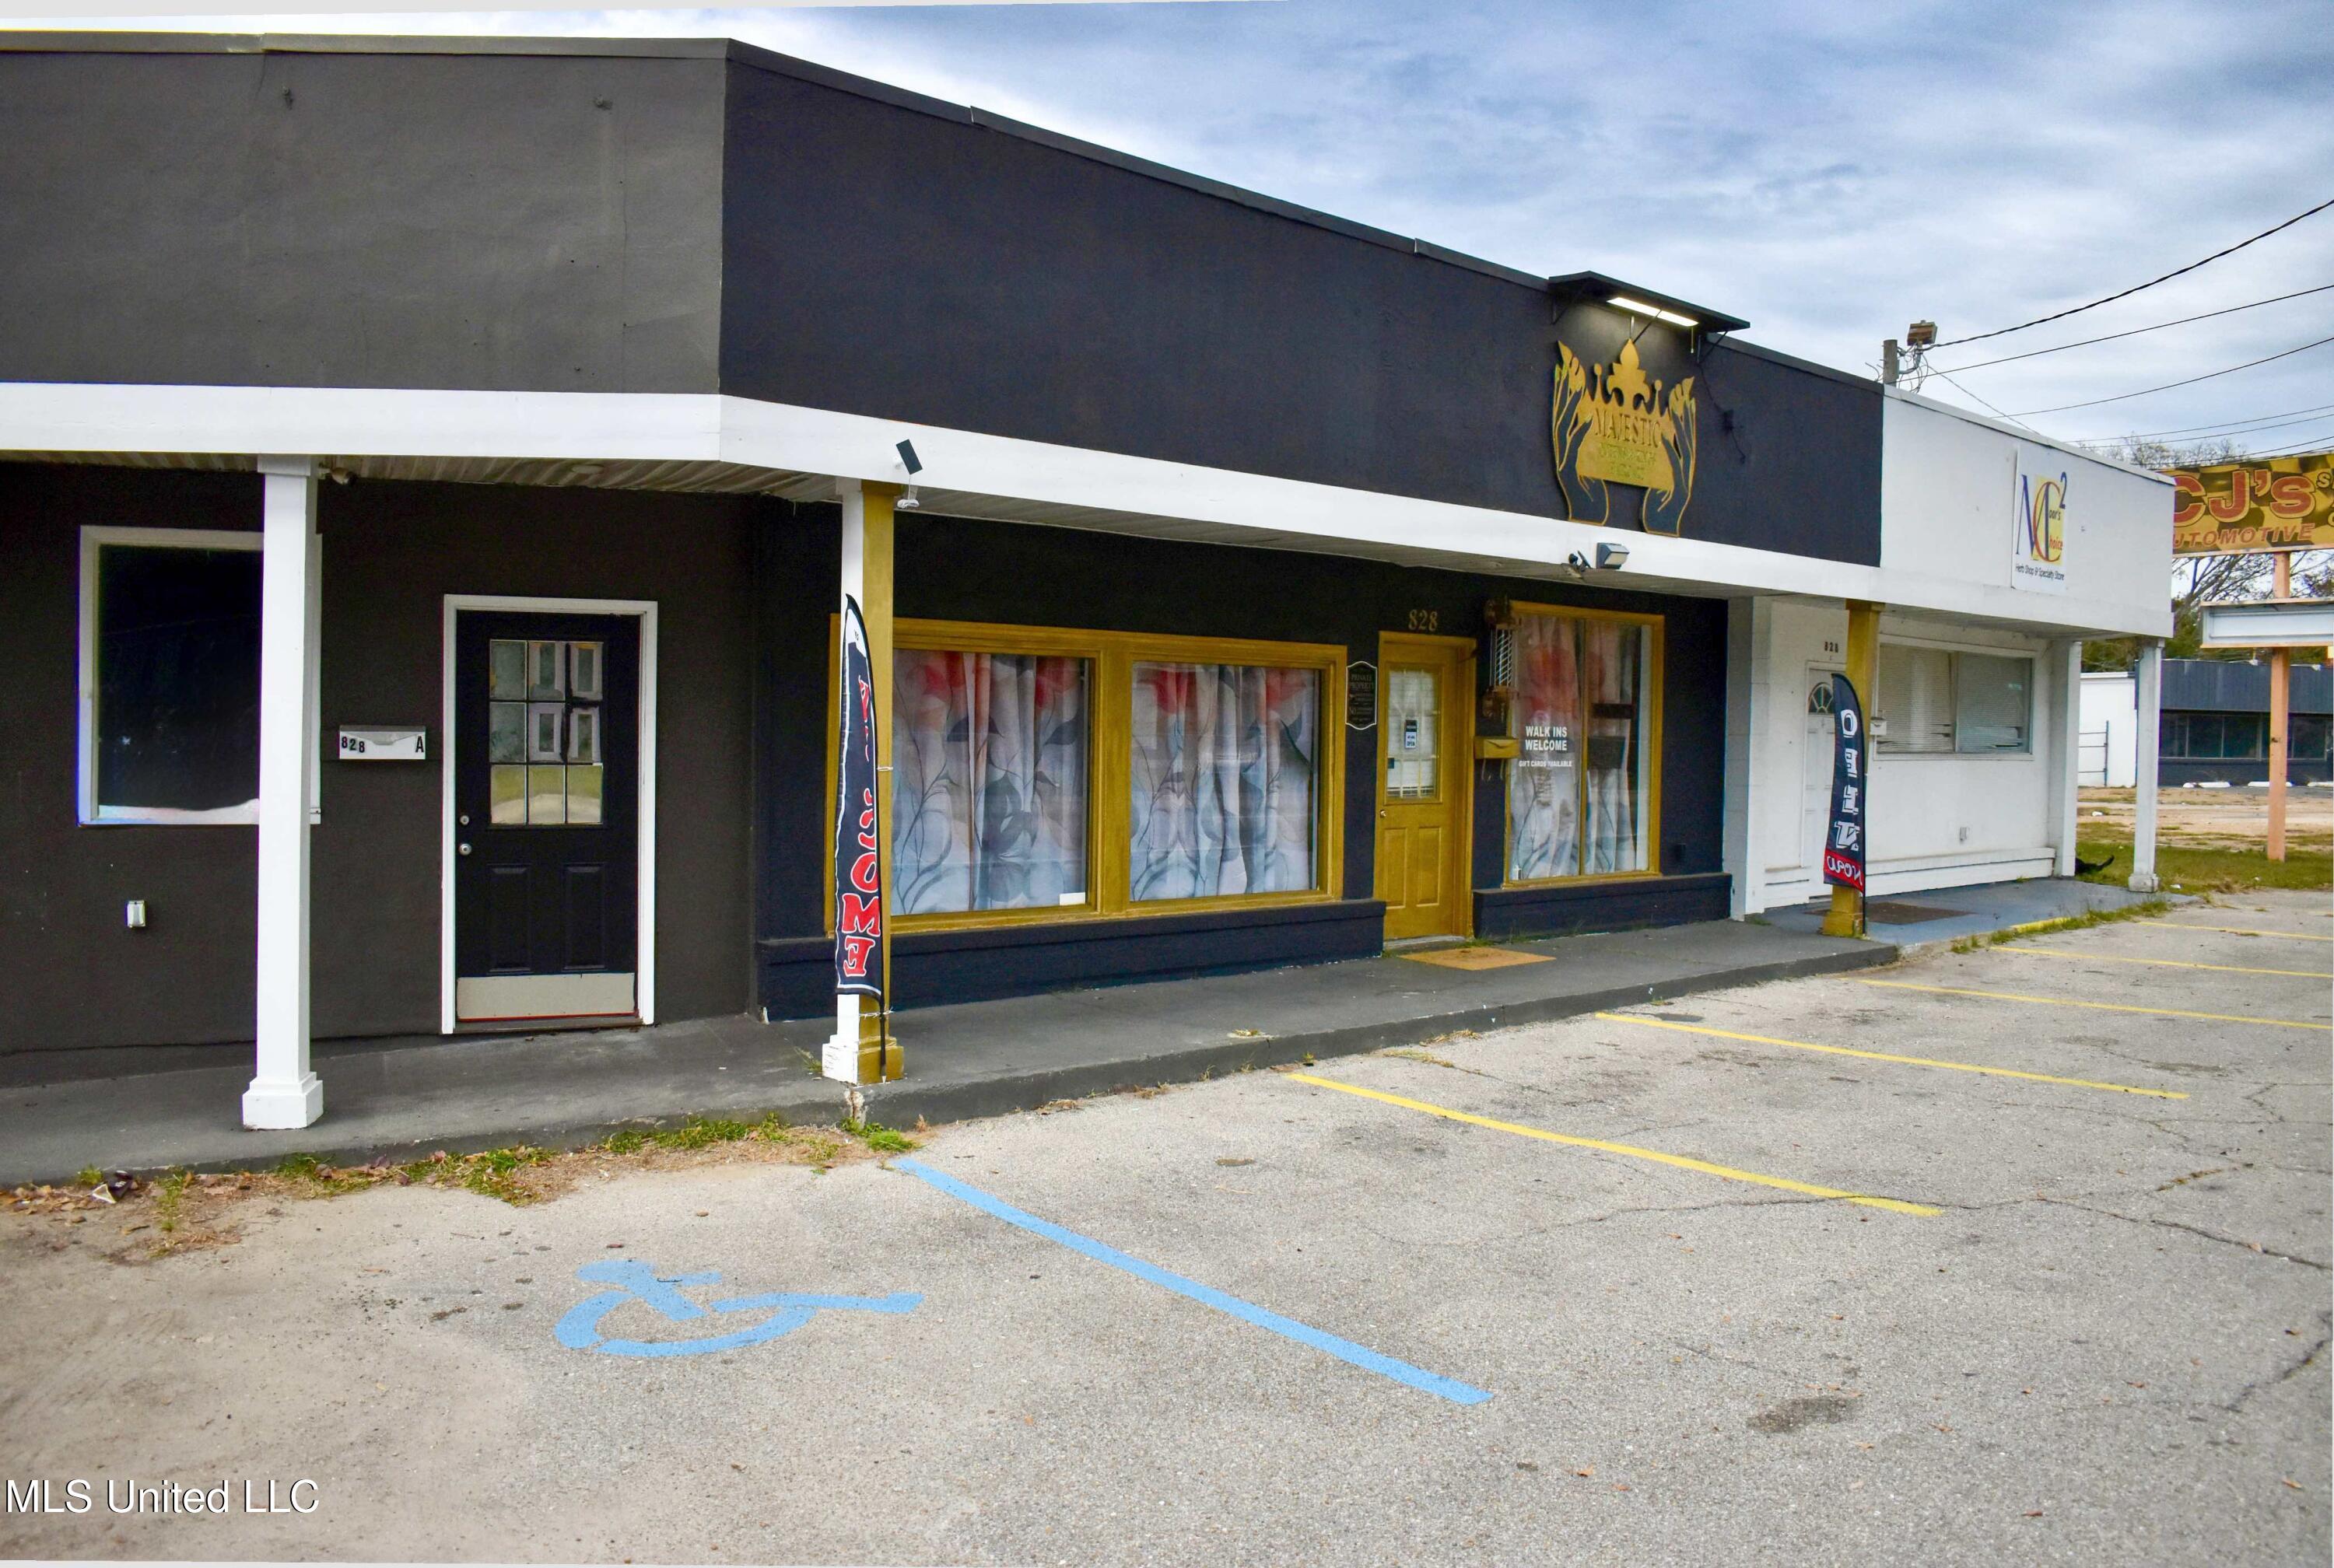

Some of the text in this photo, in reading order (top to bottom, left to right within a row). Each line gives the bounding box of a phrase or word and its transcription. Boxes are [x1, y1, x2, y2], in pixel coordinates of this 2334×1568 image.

[1594, 407, 1661, 449] MAJESTIC
[1408, 609, 1438, 632] 828
[1525, 726, 1568, 737] WALK INS
[341, 736, 425, 753] 828 A
[1525, 739, 1568, 751] WELCOME
